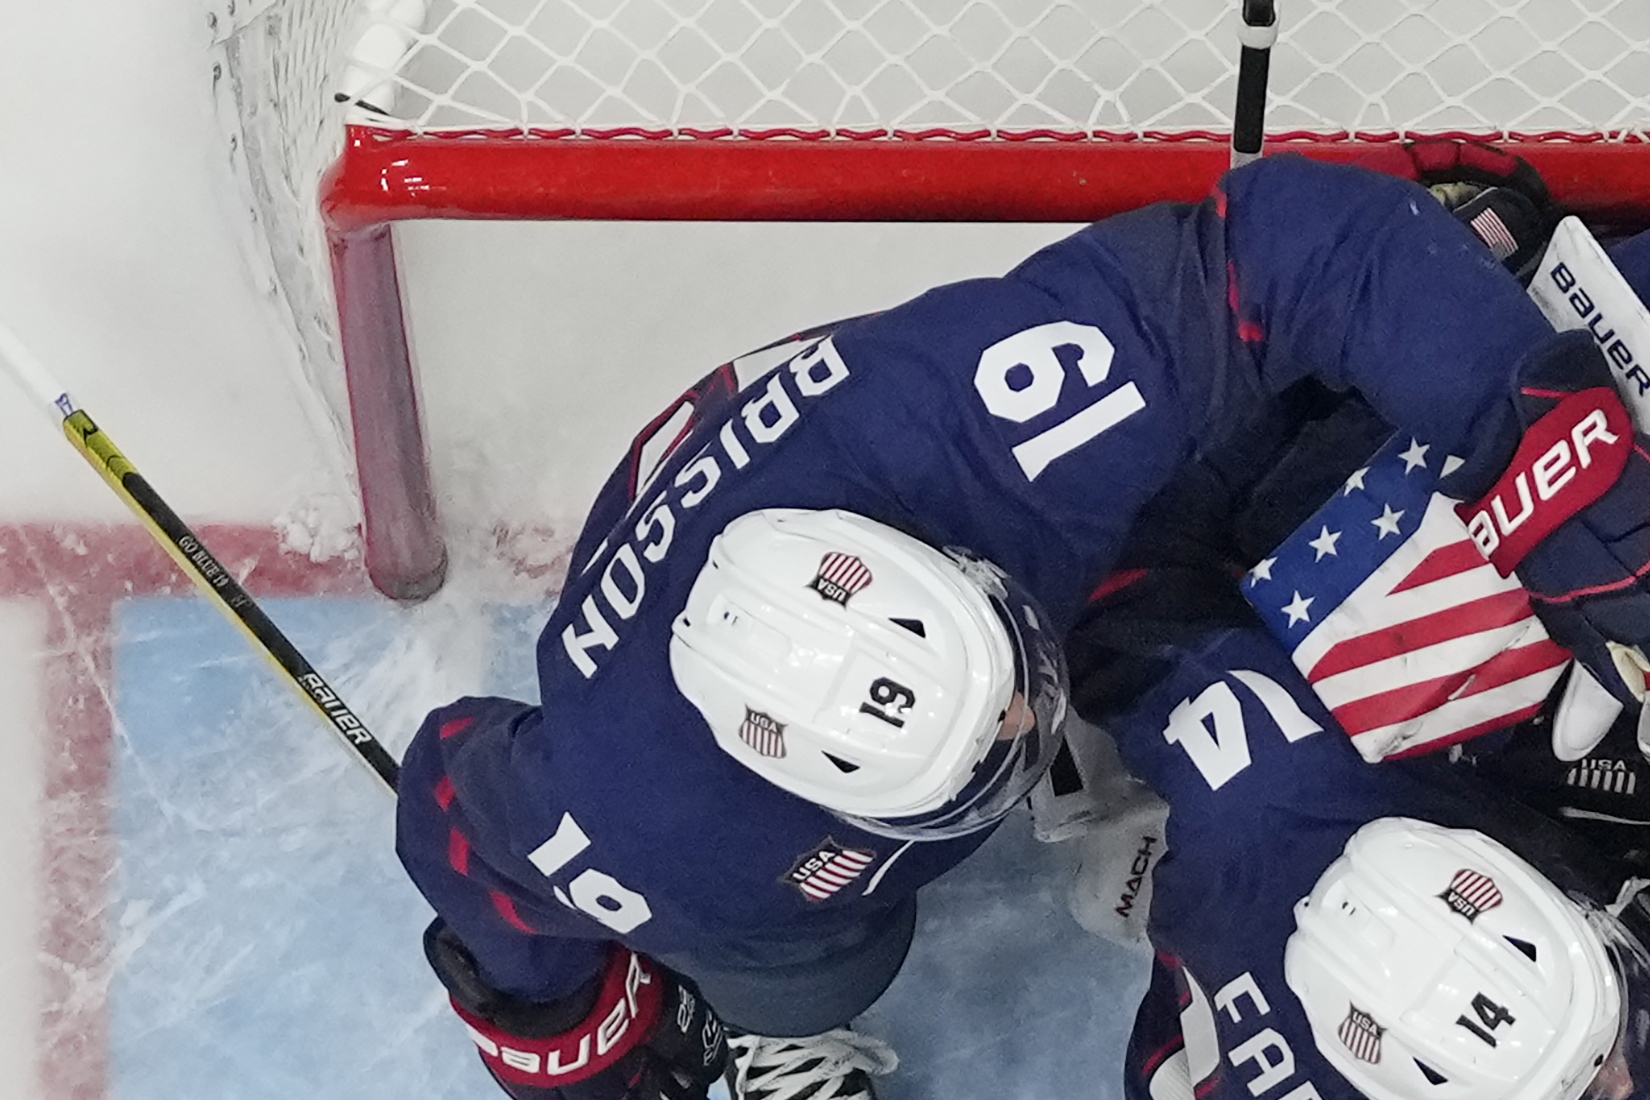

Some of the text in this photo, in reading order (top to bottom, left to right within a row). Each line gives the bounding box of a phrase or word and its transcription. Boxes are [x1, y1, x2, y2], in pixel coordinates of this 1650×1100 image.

[973, 321, 1146, 482] 19
[1466, 409, 1619, 557] AUER
[817, 578, 847, 602] USA
[750, 712, 778, 733] USA
[859, 677, 916, 728] 19
[1163, 670, 1325, 791] 14
[792, 850, 836, 881] USA
[1115, 836, 1157, 918] MACH
[1449, 891, 1476, 917] USA
[1352, 1011, 1378, 1035] USA
[1455, 992, 1516, 1049] 14
